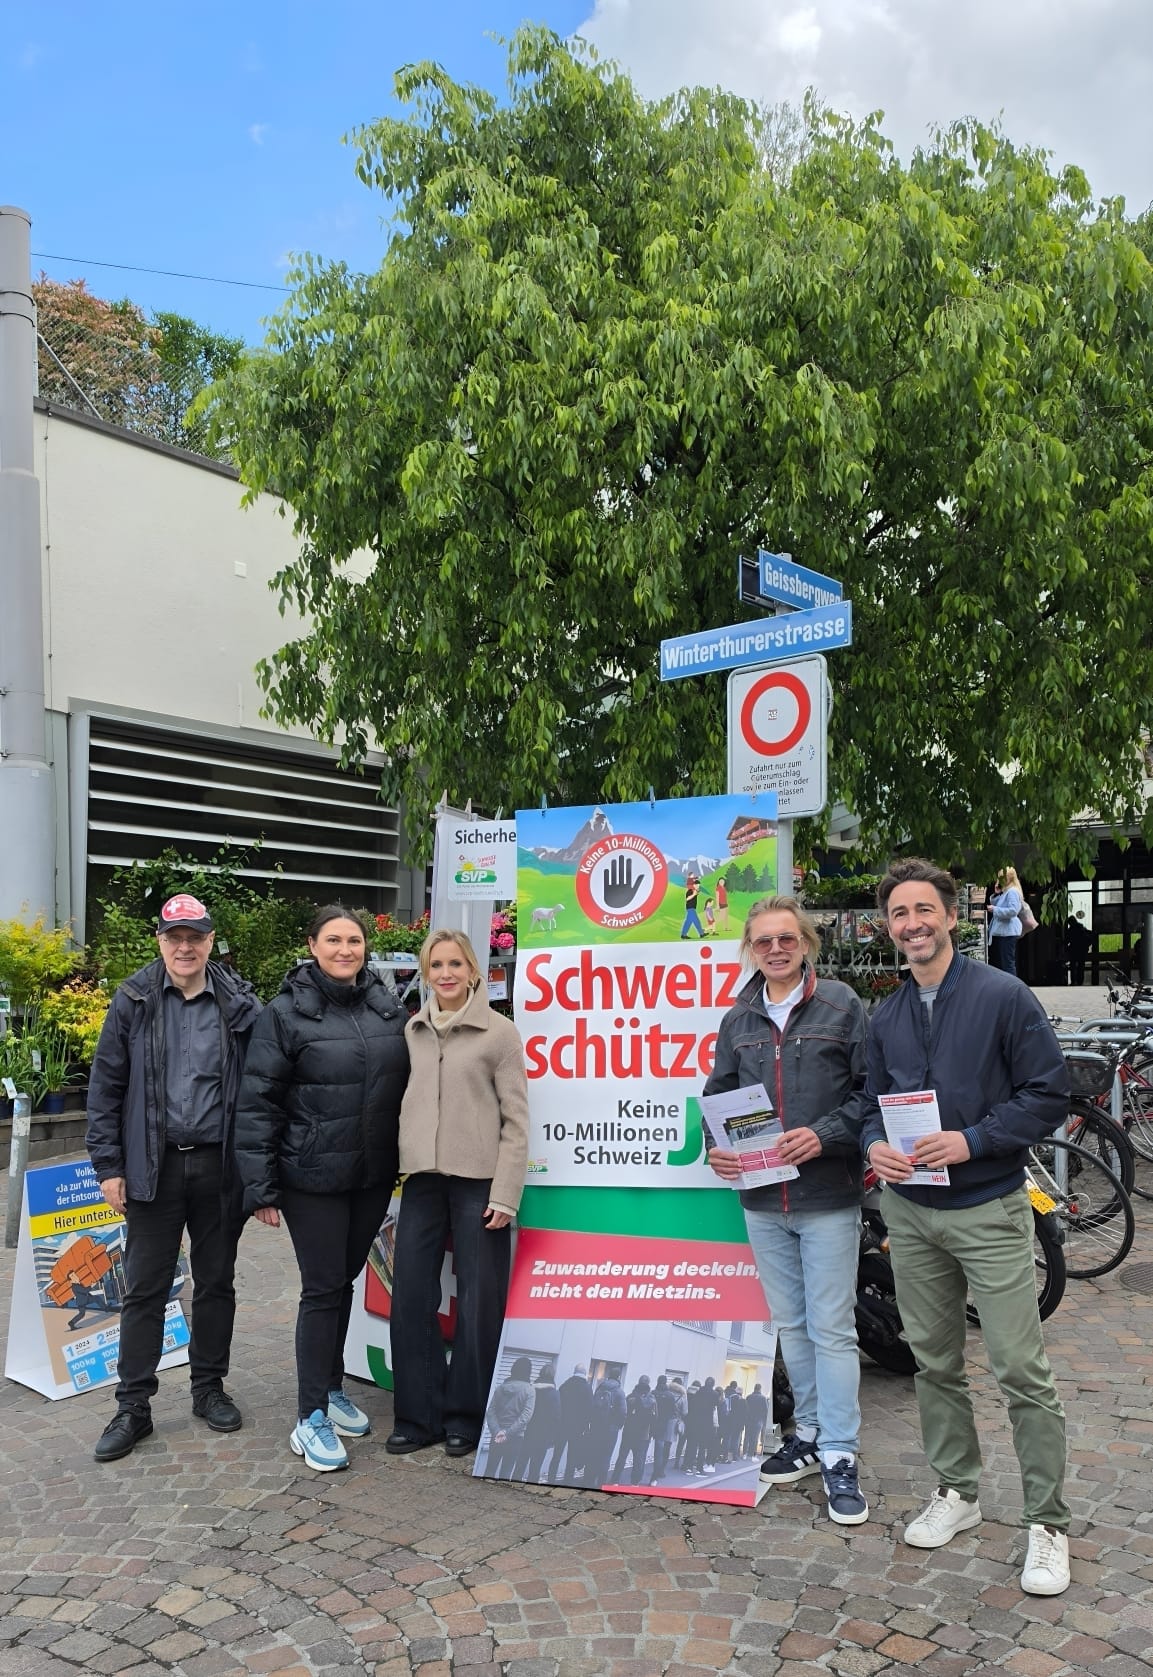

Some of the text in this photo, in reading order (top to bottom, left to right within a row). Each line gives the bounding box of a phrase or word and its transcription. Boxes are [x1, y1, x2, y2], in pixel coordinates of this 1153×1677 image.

[665, 617, 845, 670] Winterthurerstrasse
[749, 760, 802, 774] Zufahrt nur zum
[763, 782, 777, 790] zum
[778, 780, 792, 788] Ein-
[793, 777, 809, 786] oder
[778, 787, 804, 796] nlassen
[455, 828, 517, 845] Sicherhe
[580, 836, 663, 875] Keine 10-Millionen
[460, 870, 488, 883] SVP
[601, 911, 644, 927] Schweiz
[524, 946, 743, 1012] Schweiz
[525, 1017, 718, 1079] schütze
[617, 1100, 680, 1119] Keine
[542, 1122, 678, 1142] 10-Millionen
[667, 1097, 710, 1166] J
[573, 1146, 662, 1165] Schweiz
[75, 1167, 97, 1178] Volks
[69, 1182, 81, 1191] zur
[56, 1191, 104, 1206] der Entsorgu
[54, 1209, 122, 1230] Hier untersc
[532, 1260, 760, 1280] Zuwanderung deckeln,
[529, 1282, 722, 1300] nicht den Mietzins.
